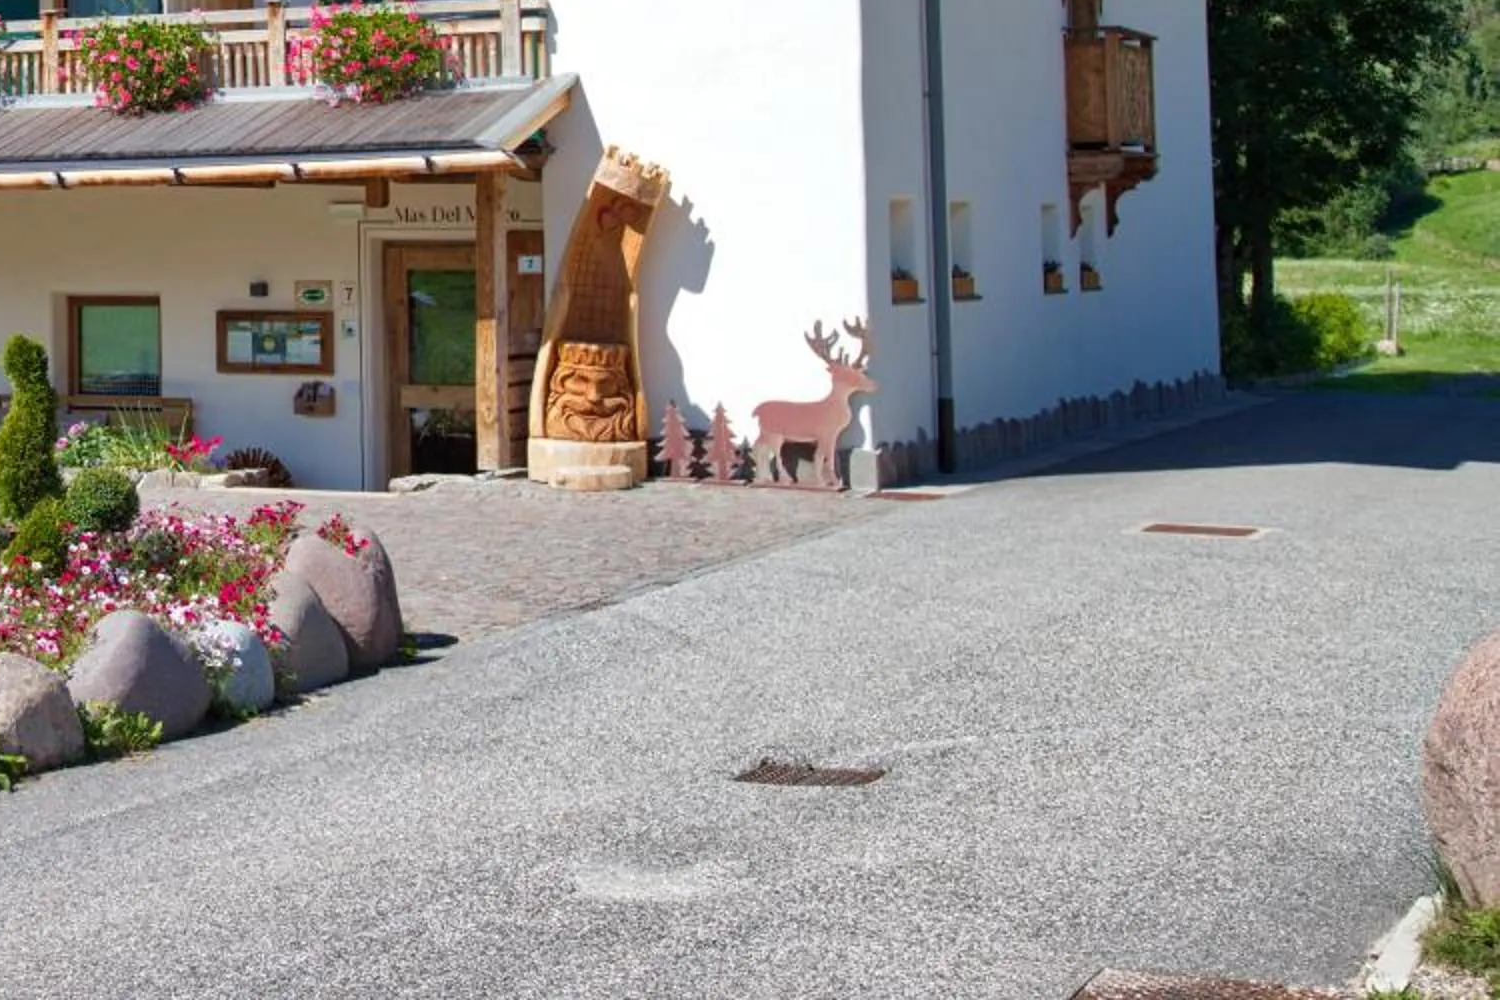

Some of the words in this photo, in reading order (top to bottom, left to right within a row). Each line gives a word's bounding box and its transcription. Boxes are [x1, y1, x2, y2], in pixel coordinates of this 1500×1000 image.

[395, 206, 426, 223] Mas
[432, 206, 461, 223] Del
[344, 286, 353, 301] 7
